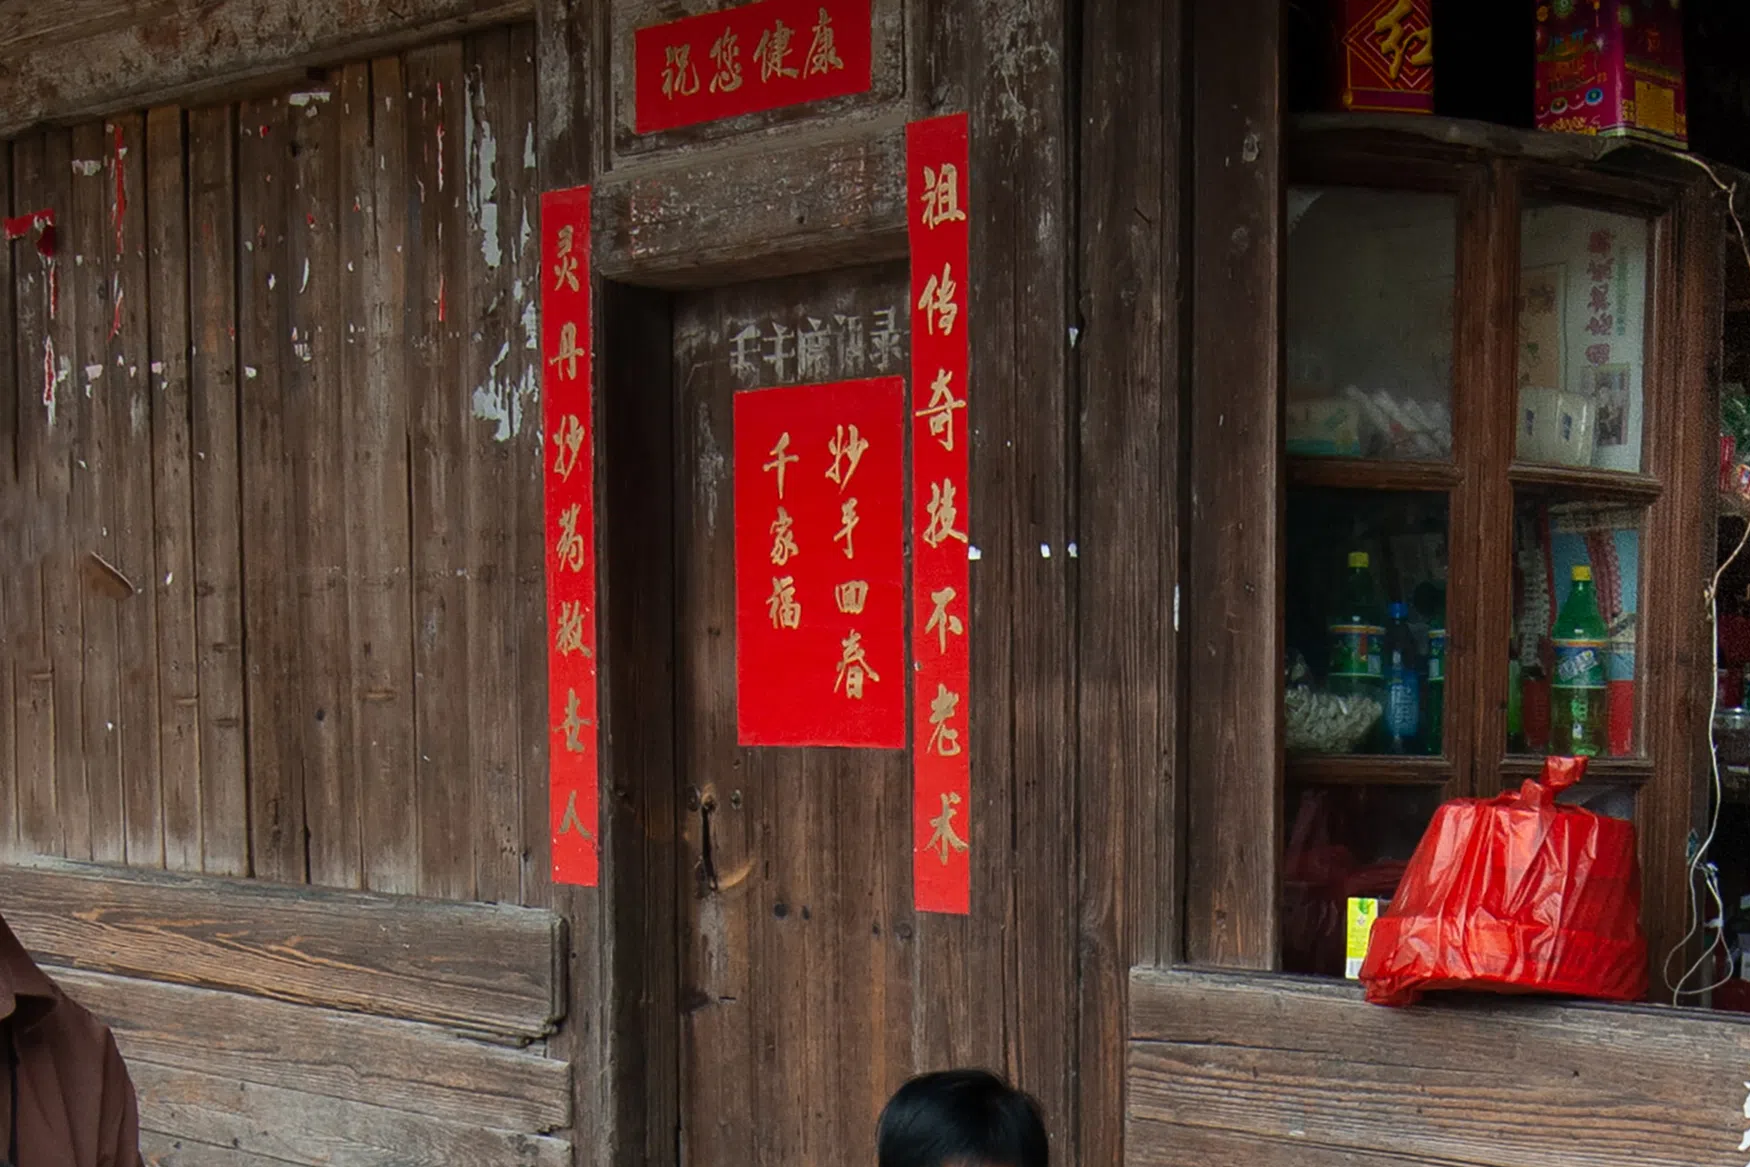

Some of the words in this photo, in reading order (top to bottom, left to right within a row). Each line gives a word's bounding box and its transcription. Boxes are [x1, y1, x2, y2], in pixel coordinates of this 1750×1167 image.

[661, 8, 844, 101] 祝您健康
[762, 431, 802, 631] 千家福
